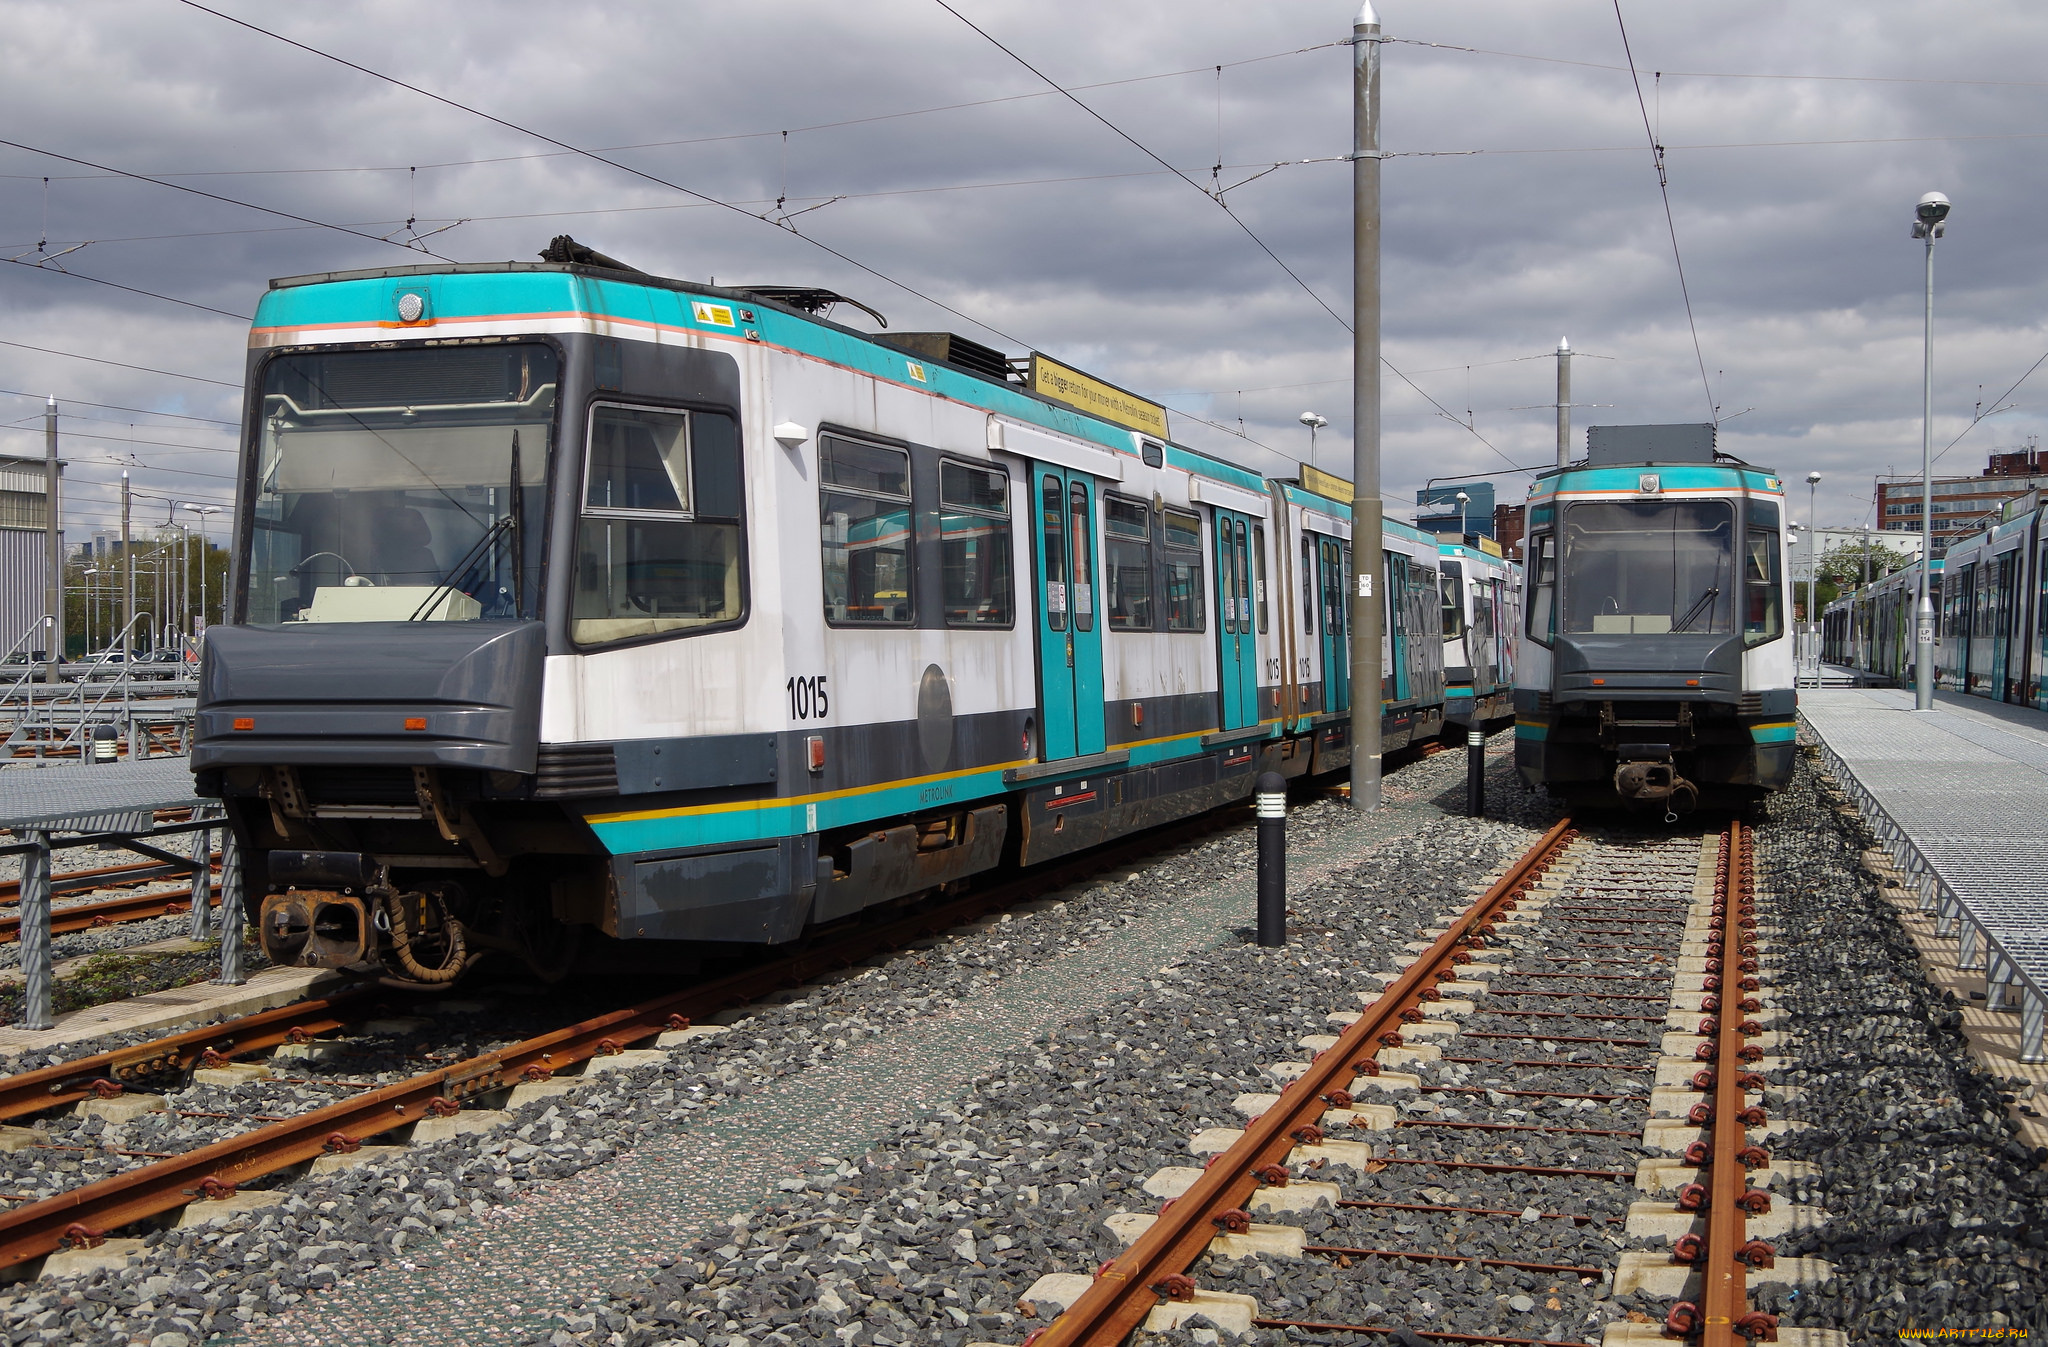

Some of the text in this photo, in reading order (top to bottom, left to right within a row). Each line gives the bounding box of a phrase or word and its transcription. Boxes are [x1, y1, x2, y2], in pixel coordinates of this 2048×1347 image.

[1041, 366, 1050, 384] Get
[1053, 371, 1069, 394] bigger
[1069, 381, 1081, 396] return
[1089, 390, 1097, 404] your
[1266, 657, 1280, 680] 1015
[1299, 657, 1310, 679] 1015
[787, 675, 828, 720] 1015
[920, 784, 953, 804] METROLINK
